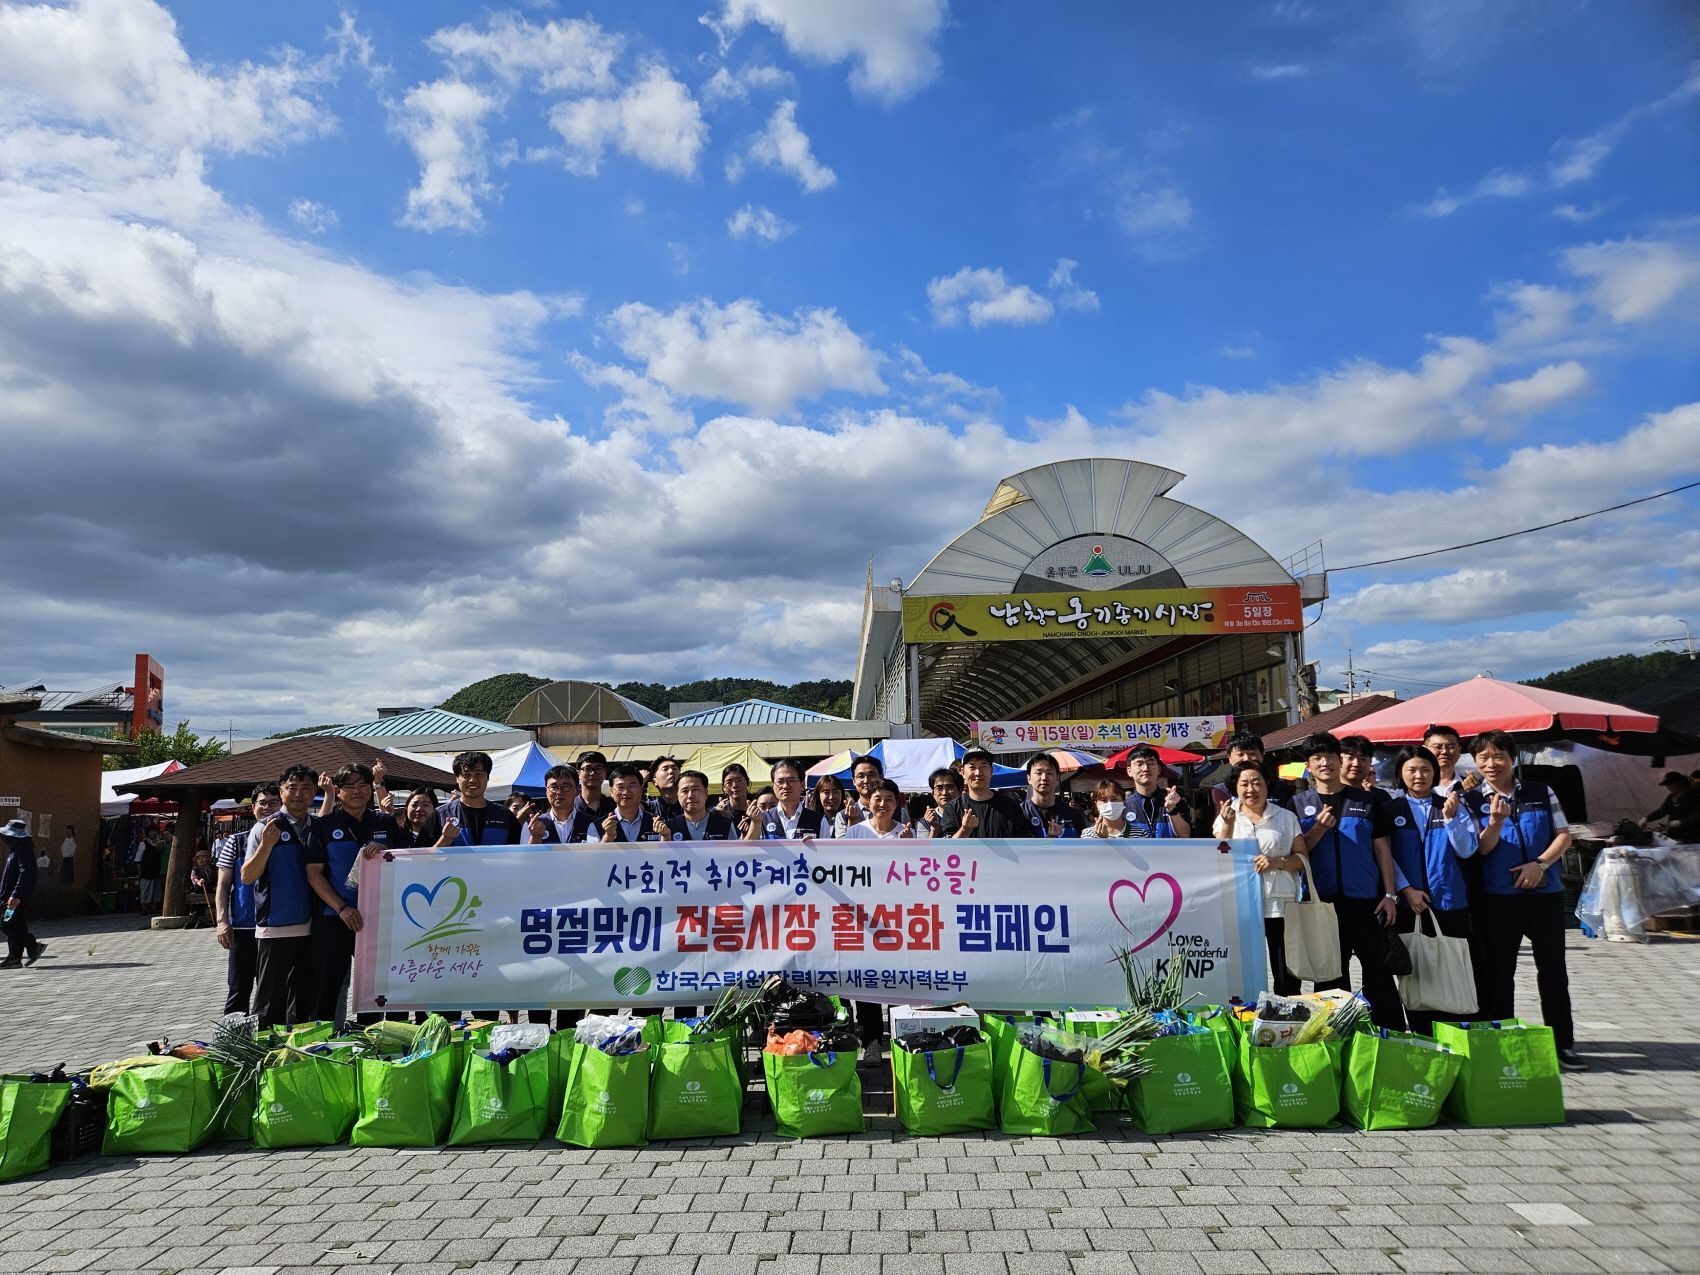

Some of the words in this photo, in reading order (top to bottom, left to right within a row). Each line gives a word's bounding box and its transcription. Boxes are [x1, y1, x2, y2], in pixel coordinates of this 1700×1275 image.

[1046, 566, 1078, 578] 울주군
[1119, 564, 1151, 576] ULJU
[1243, 606, 1272, 618] 5일장
[1097, 724, 1122, 740] 추석
[1125, 723, 1162, 739] 임시장
[1165, 722, 1190, 738] 개장
[607, 860, 691, 894] 사회적
[705, 853, 872, 896] 취약계층에게
[886, 854, 978, 895] 사랑을!
[520, 906, 662, 955] 명절맞이
[675, 904, 820, 953] 전통시장
[831, 903, 944, 952] 활성화
[956, 904, 1070, 953] 캠페인
[1168, 931, 1203, 947] Love
[427, 943, 451, 961] 함께
[390, 959, 445, 983] 아름다운
[449, 959, 484, 978] 세상
[1156, 958, 1215, 979] KNP
[845, 969, 969, 992] 새울원자력본부
